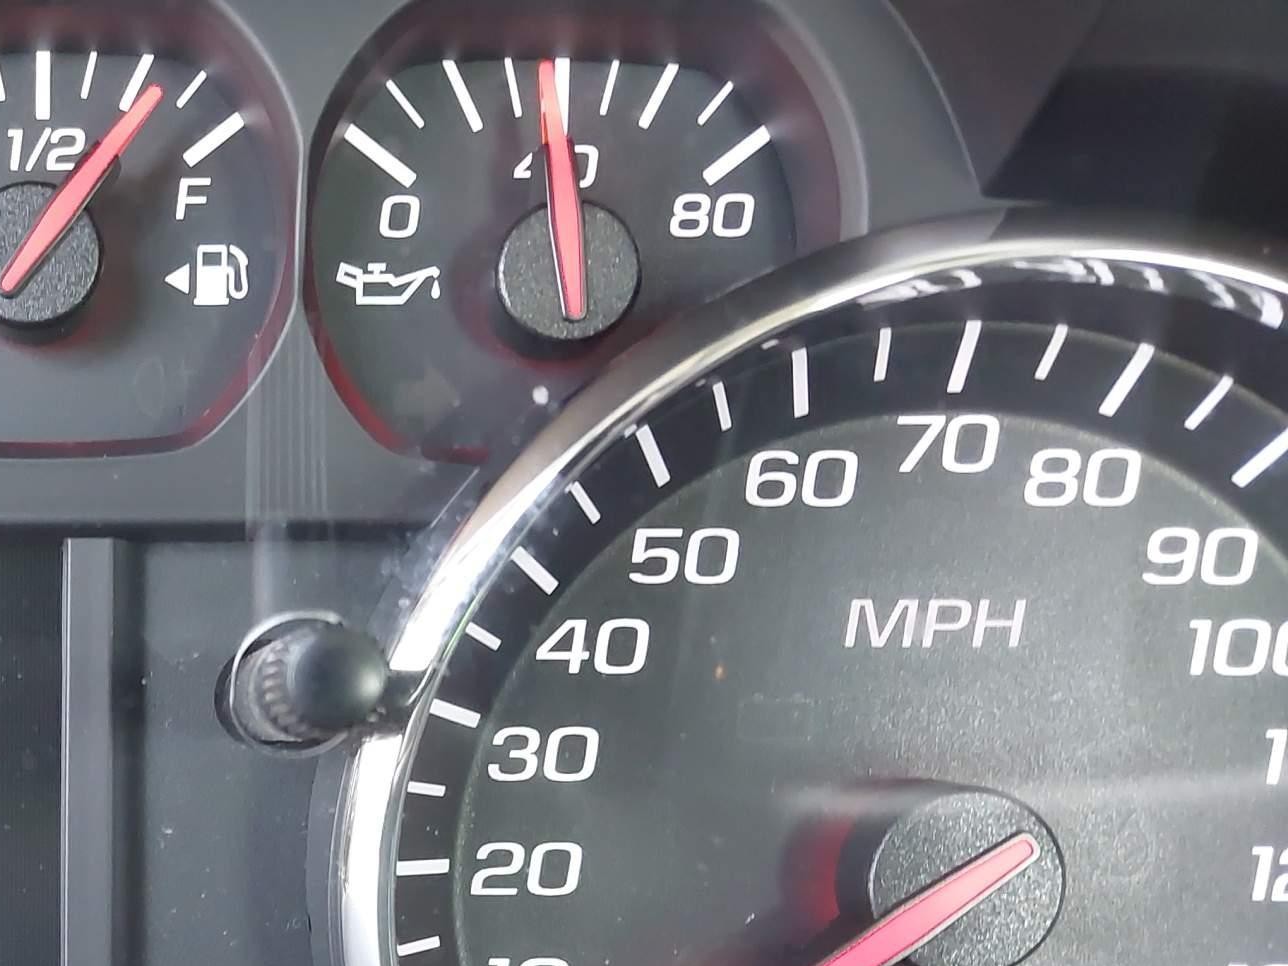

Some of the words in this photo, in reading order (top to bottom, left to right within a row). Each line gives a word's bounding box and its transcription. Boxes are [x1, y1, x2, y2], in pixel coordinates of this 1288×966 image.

[8, 128, 86, 172] 1/2
[176, 178, 211, 219] F
[380, 195, 420, 238] 0
[670, 193, 754, 237] 80
[897, 414, 1000, 473] 70
[746, 450, 858, 507] 60
[1024, 448, 1141, 506] 80
[629, 528, 739, 584] 50
[1142, 526, 1259, 585] 90
[536, 619, 649, 674] 40
[845, 599, 1026, 648] MPH
[488, 727, 599, 781] 30
[471, 842, 582, 896] 20
